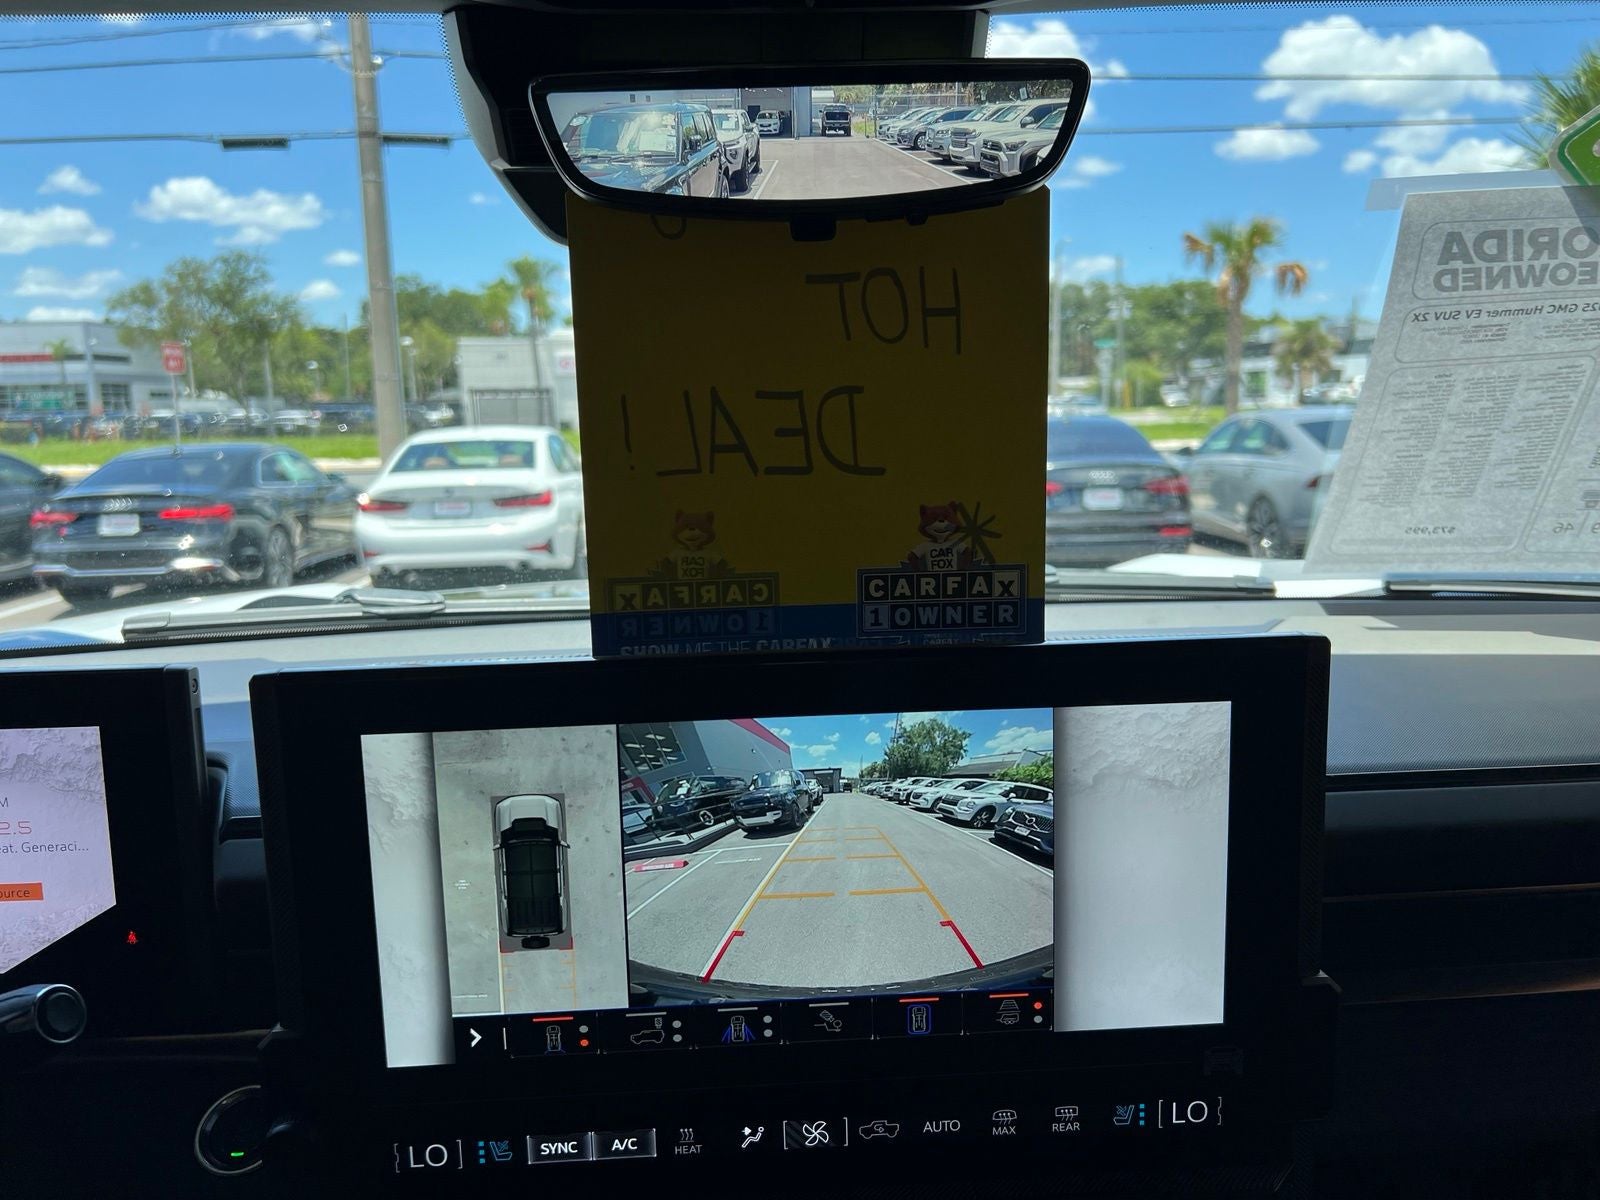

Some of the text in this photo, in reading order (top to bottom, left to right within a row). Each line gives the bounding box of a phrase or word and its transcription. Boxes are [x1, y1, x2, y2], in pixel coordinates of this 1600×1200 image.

[930, 547, 954, 559] CAR
[931, 559, 954, 570] FOX
[867, 574, 1016, 598] CARFAX
[894, 604, 1015, 627] OWNER
[719, 640, 750, 653] THE
[21, 841, 89, 853] Generaci...
[1172, 1101, 1209, 1124] LO
[923, 1120, 961, 1134] AUTO
[992, 1126, 1016, 1136] MAX
[1052, 1122, 1081, 1132] REAR
[540, 1141, 578, 1155] SYNC
[611, 1137, 638, 1151] A/C
[674, 1144, 703, 1155] HEAT
[409, 1144, 448, 1168] LO
